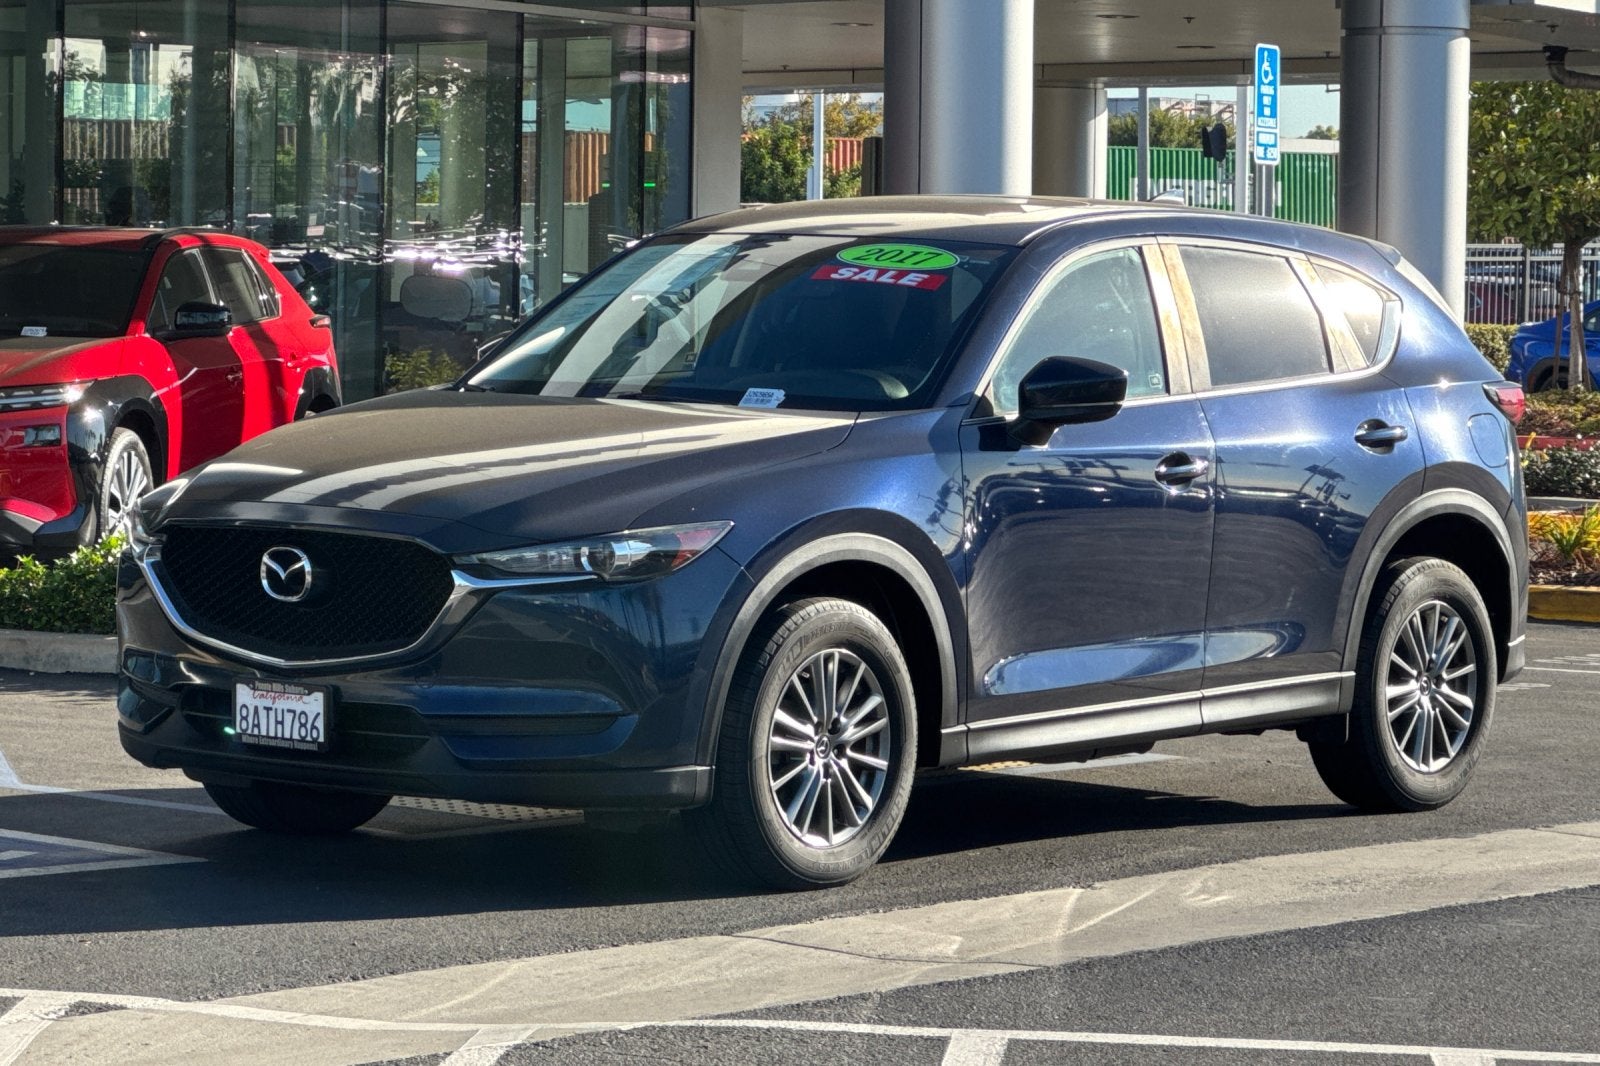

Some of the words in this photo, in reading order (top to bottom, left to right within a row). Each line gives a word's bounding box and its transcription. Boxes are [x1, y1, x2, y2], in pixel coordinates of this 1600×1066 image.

[851, 247, 943, 266] 2017
[830, 267, 930, 287] SALE
[252, 691, 310, 705] California
[239, 704, 321, 741] 8ATH786
